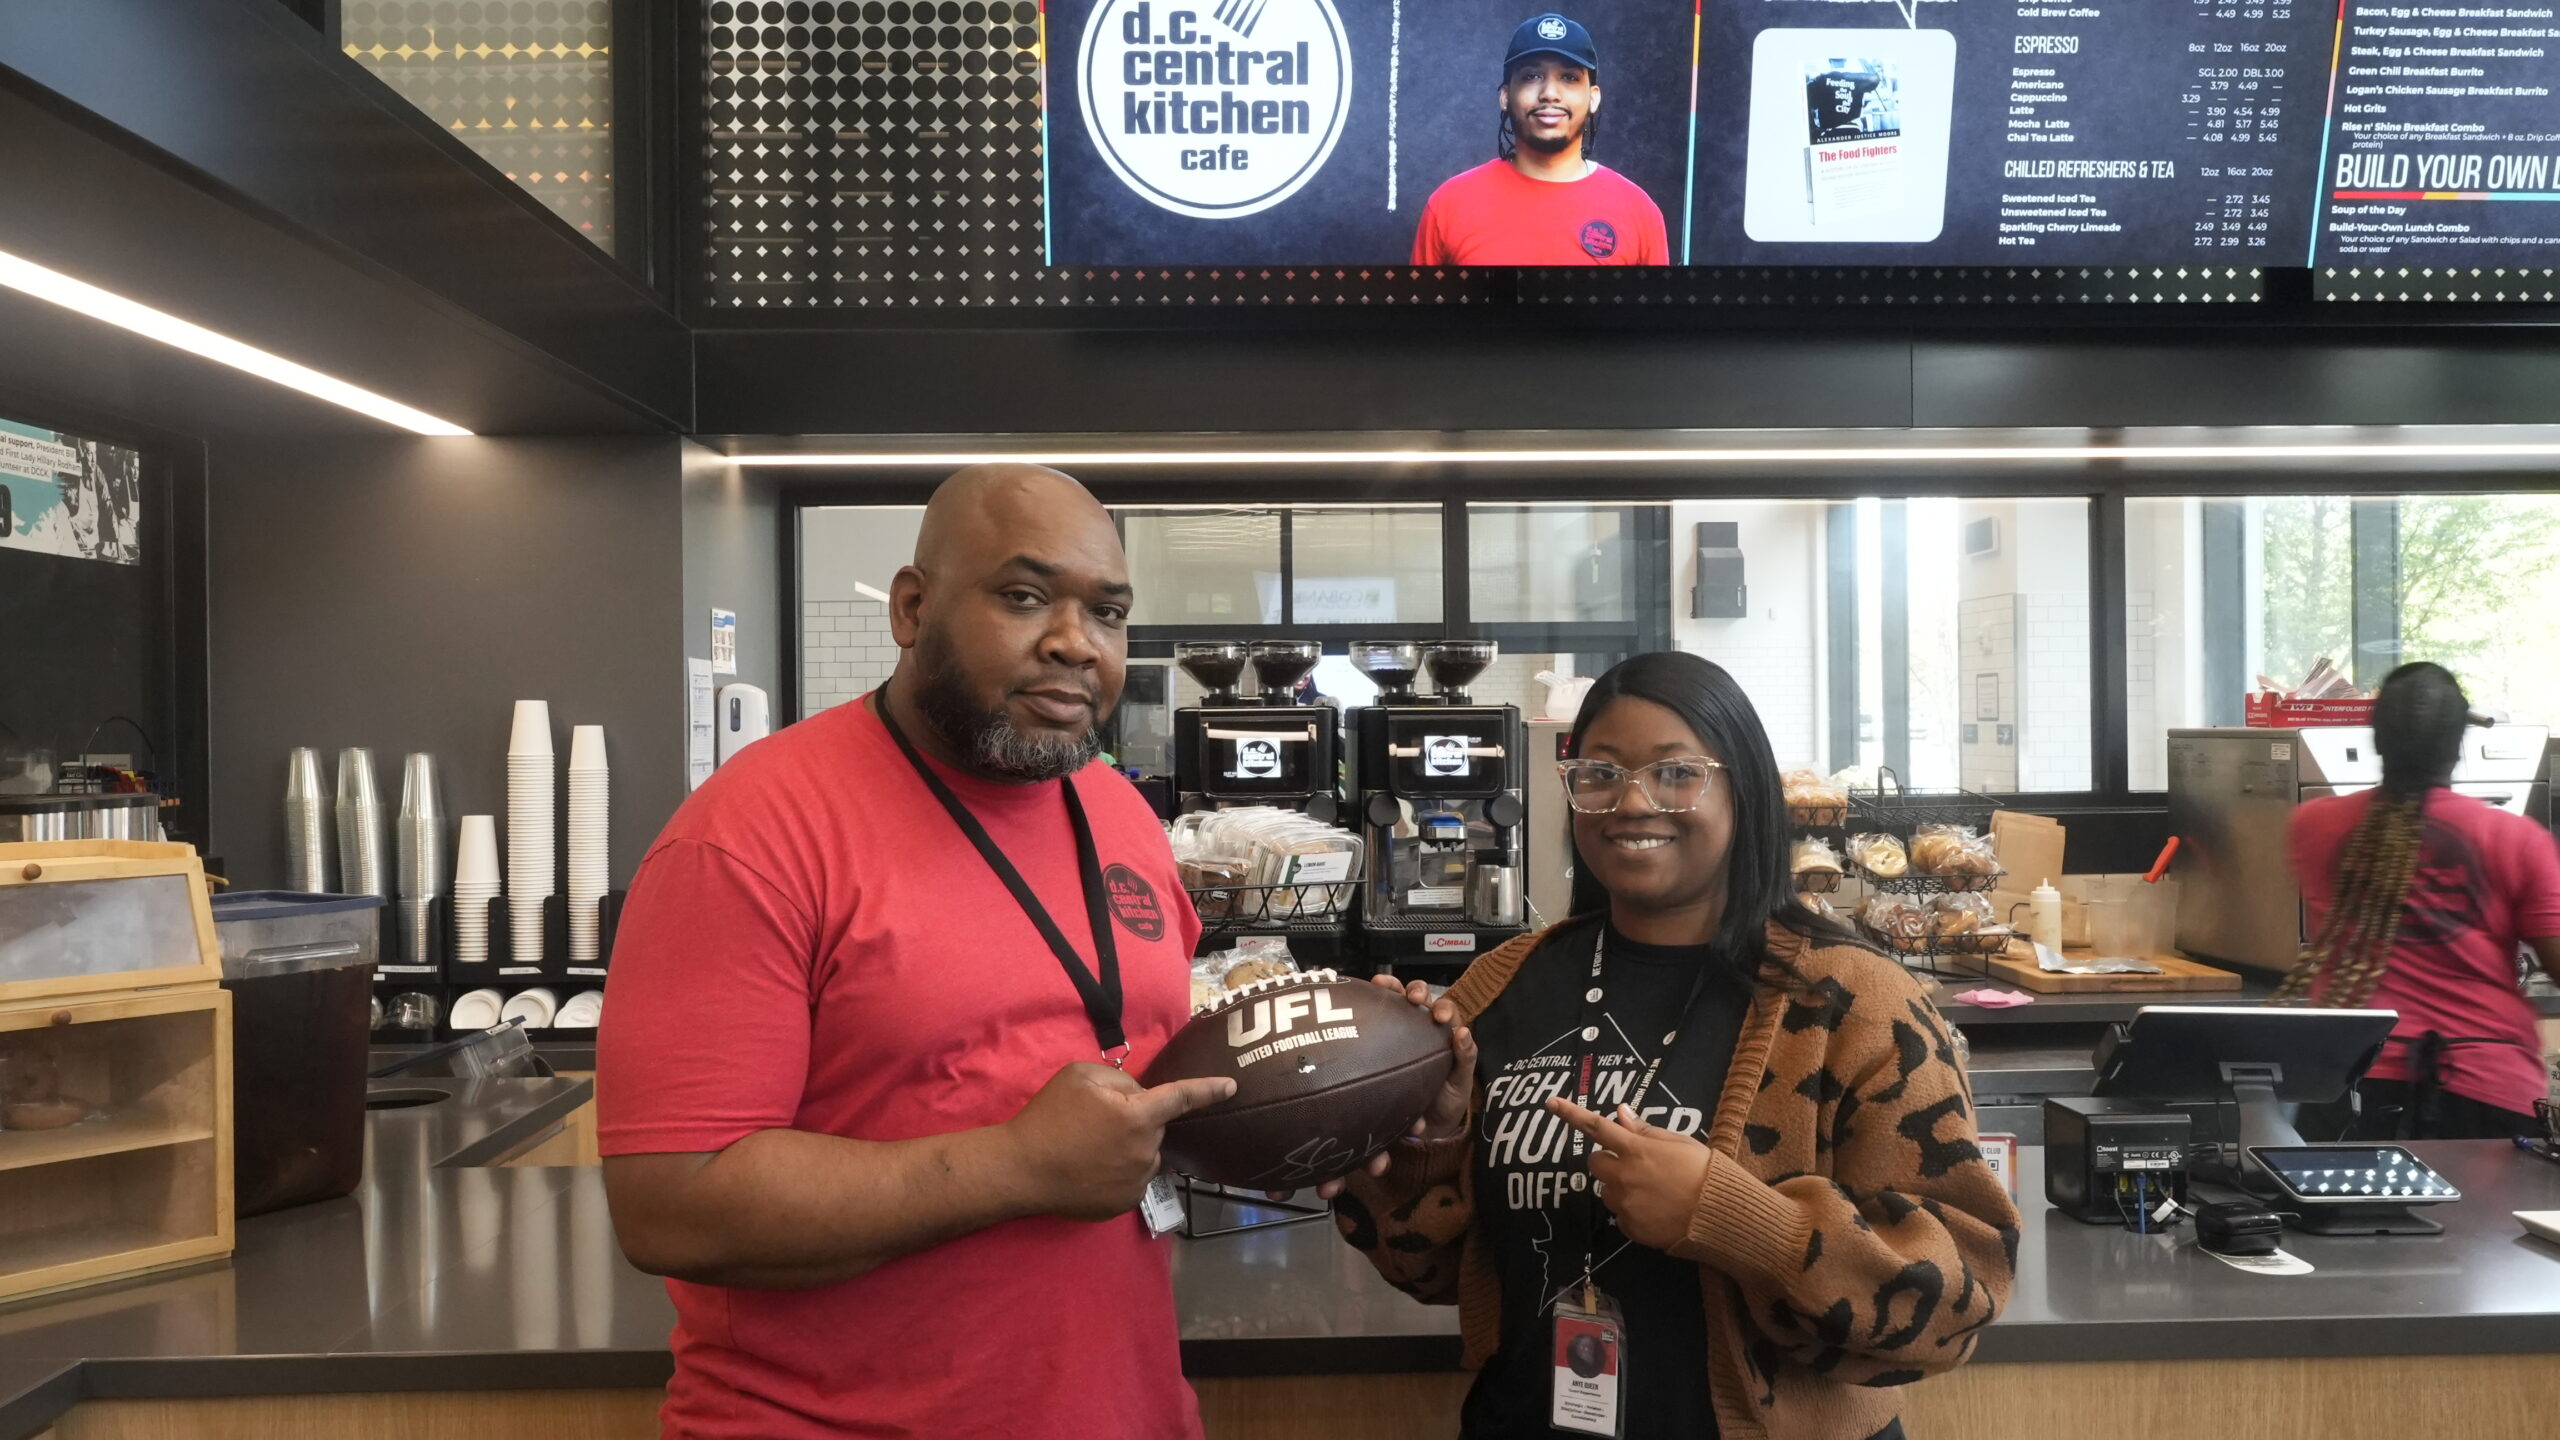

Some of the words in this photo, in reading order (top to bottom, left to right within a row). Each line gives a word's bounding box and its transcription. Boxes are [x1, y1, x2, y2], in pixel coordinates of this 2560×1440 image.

[2017, 8, 2039, 16] Cold
[2041, 8, 2067, 16] Brew
[2069, 8, 2100, 17] Coffee
[2216, 10, 2236, 18] 4.49
[2244, 10, 2263, 18] 4.99
[2272, 10, 2290, 18] 5.25
[2356, 7, 2389, 17] Bacon,
[2391, 8, 2410, 18] Egg
[2412, 8, 2419, 16] &
[2421, 8, 2456, 16] Cheese
[2458, 8, 2504, 17] Breakfast
[2506, 9, 2553, 17] Sandwich
[1123, 1, 1212, 44] d.c.
[2354, 27, 2387, 37] Turkey
[2388, 27, 2431, 37] Sausage,
[2433, 27, 2452, 38] Egg
[2454, 28, 2461, 36] &
[2463, 28, 2498, 36] Cheese
[2500, 28, 2546, 37] Breakfast
[2015, 36, 2078, 53] ESPRESSO
[2189, 43, 2205, 52] 8oz
[2214, 43, 2232, 52] 12oz
[2241, 43, 2259, 52] 16oz
[2265, 43, 2286, 52] 20oz
[2351, 47, 2380, 56] Steak,
[2383, 47, 2402, 57] Egg
[2404, 47, 2411, 55] &
[2413, 47, 2448, 56] Cheese
[2450, 48, 2495, 56] Breakfast
[2498, 48, 2544, 57] Sandwich
[1123, 41, 1309, 85] central
[2013, 68, 2055, 77] Espresso
[2218, 68, 2238, 77] 2.00
[2243, 69, 2263, 77] DBL
[2264, 69, 2284, 77] 3.00
[2349, 66, 2377, 75] Green
[2380, 67, 2401, 75] Chili
[2403, 67, 2448, 76] Breakfast
[2450, 67, 2484, 76] Burrito
[1826, 78, 1855, 89] Feeding
[2011, 80, 2064, 89] Americano
[2210, 81, 2228, 90] 3.79
[2238, 82, 2258, 90] 4.49
[2347, 85, 2383, 96] Logan's
[2385, 85, 2424, 94] Chicken
[2426, 86, 2466, 96] Sausage
[2468, 87, 2513, 95] Breakfast
[2515, 87, 2548, 95] Burrito
[2011, 93, 2067, 103] Cappuccino
[2182, 94, 2200, 103] 3.29
[1124, 91, 1310, 134] kitchen
[2010, 106, 2034, 114] Latte
[2207, 107, 2226, 116] 3.90
[2234, 107, 2252, 115] 4.54
[2261, 108, 2280, 116] 4.99
[2344, 104, 2361, 112] Hot
[2364, 104, 2386, 113] Grits
[2009, 120, 2040, 128] Mocha
[2045, 120, 2069, 128] Latte
[2207, 120, 2224, 128] 4.81
[2236, 120, 2252, 128] 5.17
[2260, 120, 2278, 128] 5.45
[2342, 122, 2362, 131] Rise
[2375, 122, 2401, 131] Shine
[2403, 123, 2449, 132] Breakfast
[2451, 123, 2485, 132] Combo
[1816, 135, 1852, 143] ALEXANDER
[2007, 133, 2029, 141] Chai
[2031, 133, 2047, 142] Tea
[2050, 134, 2074, 142] Latte
[2203, 133, 2223, 141] 4.08
[2231, 134, 2250, 142] 4.99
[2259, 133, 2277, 142] 5.45
[2353, 141, 2383, 149] protein)
[1180, 144, 1248, 170] cafe
[1819, 151, 1836, 163] The
[1839, 148, 1860, 160] Food
[1862, 145, 1897, 158] Fighters
[2005, 160, 2055, 177] CHILLED
[2057, 161, 2136, 178] REFRESHERS
[2139, 161, 2148, 178] &
[2151, 161, 2174, 178] TEA
[2201, 168, 2219, 176] 12oz
[2228, 167, 2246, 176] 16oz
[2252, 168, 2273, 176] 20oz
[2336, 154, 2409, 188] BUILD
[2417, 154, 2481, 189] YOUR
[2487, 155, 2548, 189] OWN
[2002, 194, 2055, 202] Sweetened
[2057, 194, 2077, 202] Iced
[2080, 195, 2096, 203] Tea
[2226, 195, 2243, 203] 2.72
[2252, 195, 2270, 203] 3.45
[2002, 208, 2066, 216] Unsweetened
[2068, 208, 2088, 216] Iced
[2090, 208, 2106, 216] Tea
[2224, 209, 2242, 217] 2.72
[2250, 209, 2268, 217] 3.45
[2332, 205, 2356, 215] Soup
[2358, 205, 2368, 214] of
[2369, 206, 2385, 214] the
[2387, 206, 2406, 216] Day
[2000, 223, 2045, 233] Sparkling
[2047, 223, 2079, 233] Cherry
[2081, 223, 2121, 231] Limeade
[2195, 223, 2214, 231] 2.49
[2222, 223, 2240, 231] 3.49
[2248, 223, 2267, 231] 4.49
[2330, 223, 2403, 231] Build-Your-Own
[2405, 224, 2434, 232] Lunch
[2436, 224, 2470, 232] Combo
[2018, 237, 2035, 245] Tea
[2195, 237, 2212, 246] 2.72
[2221, 237, 2239, 246] 2.99
[2248, 237, 2265, 246] 3.26
[8, 437, 34, 449] support,
[36, 442, 64, 455] President
[66, 449, 75, 458] Bill
[6, 448, 19, 458] First
[21, 451, 35, 463] Lady
[37, 455, 56, 468] Hillary
[58, 459, 81, 471] Rodham
[23, 466, 30, 474] at
[1112, 893, 1152, 906] central
[1118, 905, 1159, 920] kitchen
[1227, 988, 1354, 1048] UFL
[1236, 1044, 1273, 1068] UNITED
[1273, 1031, 1323, 1054] FOOTBALL
[1324, 1025, 1359, 1043] LEAGUE
[1513, 1059, 1527, 1071] DC
[1527, 1055, 1571, 1070] CENTRAL
[1573, 1143, 1583, 1156] WE
